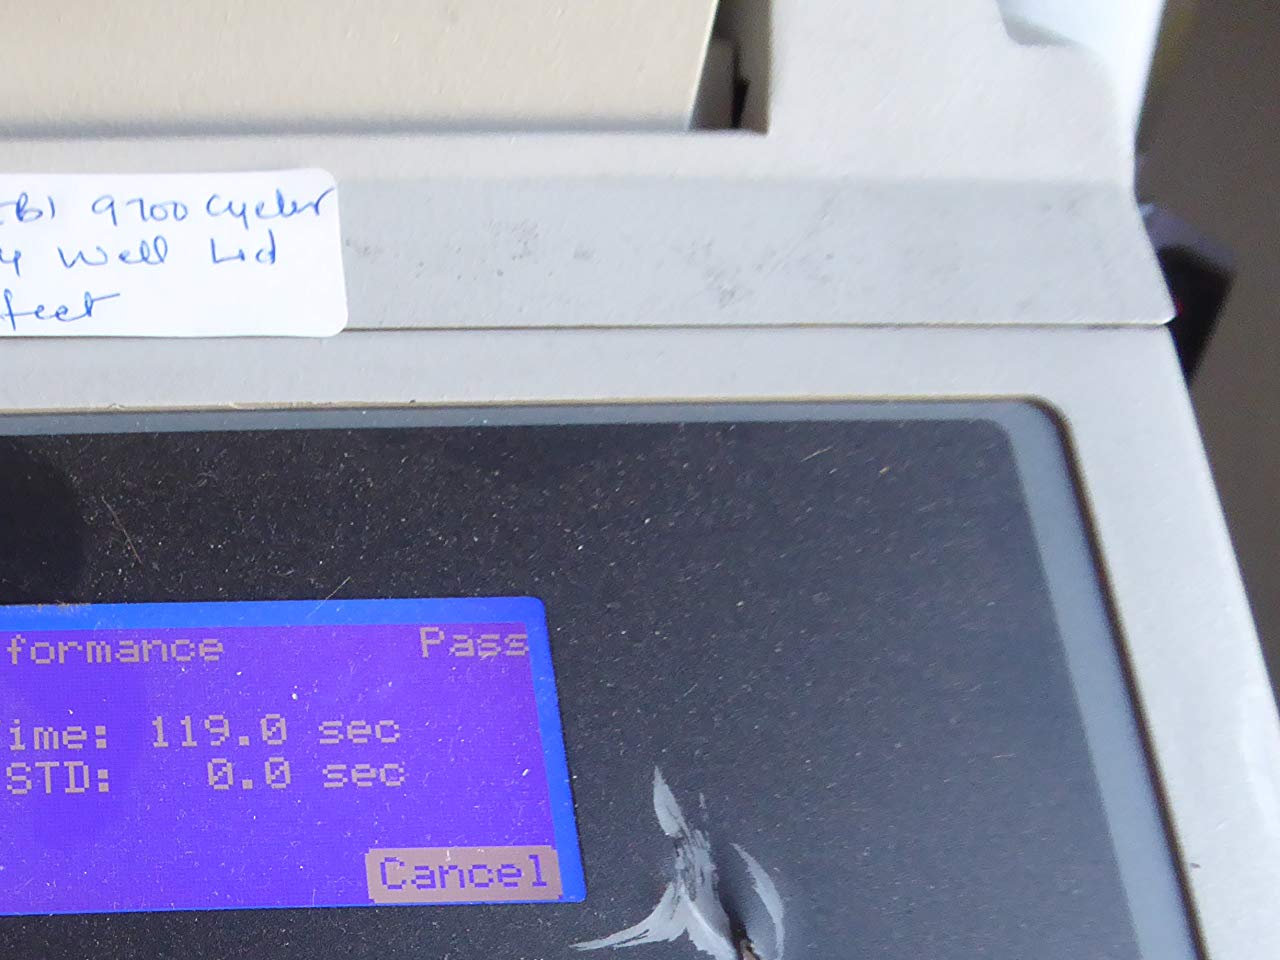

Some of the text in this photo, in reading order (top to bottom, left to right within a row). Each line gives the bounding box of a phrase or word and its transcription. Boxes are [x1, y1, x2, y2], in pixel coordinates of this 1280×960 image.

[91, 194, 189, 227] 9700
[419, 626, 530, 659] Pass
[151, 713, 288, 748] 119.0
[318, 718, 401, 745] sec
[5, 762, 110, 796] STD:
[207, 756, 292, 791] 0.0
[322, 761, 406, 789] sec
[379, 853, 548, 891] Cancel
